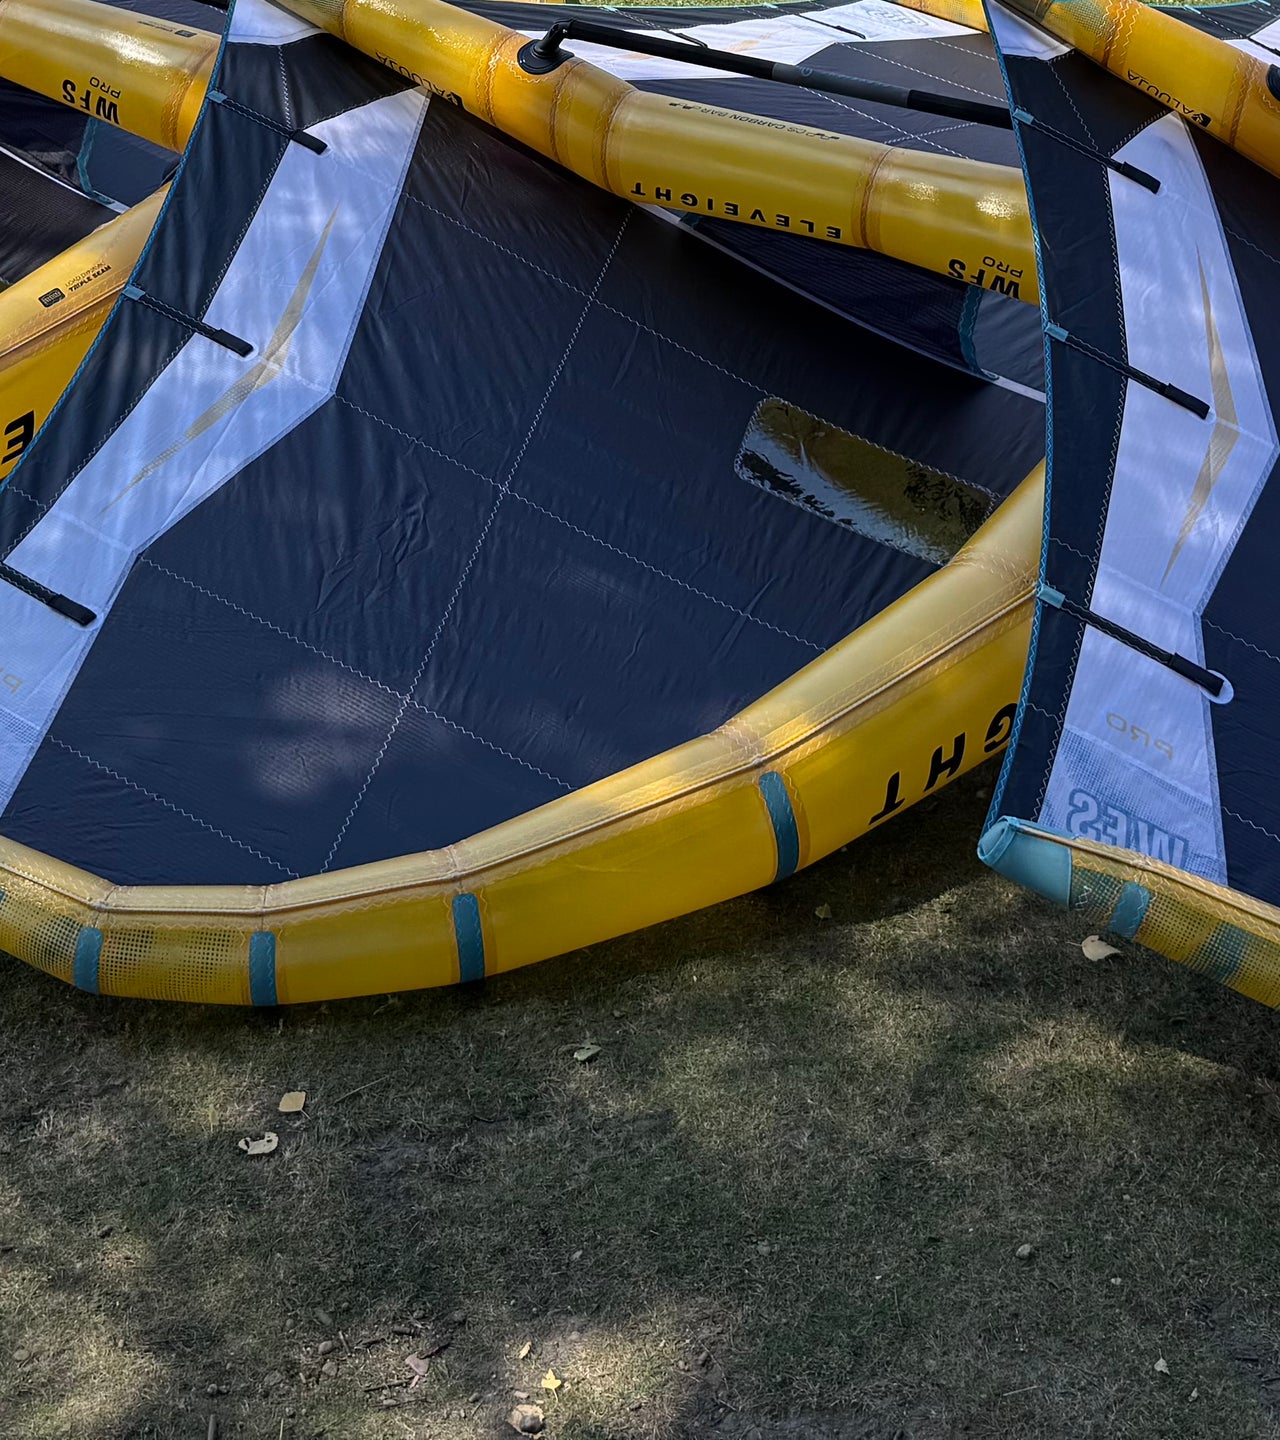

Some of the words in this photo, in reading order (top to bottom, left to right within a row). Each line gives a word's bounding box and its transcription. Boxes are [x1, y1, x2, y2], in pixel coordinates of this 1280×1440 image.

[89, 76, 122, 99] PRO
[62, 79, 120, 125] WFS
[729, 113, 786, 130] CARBON
[631, 182, 842, 240] ELEVEIGHT
[68, 276, 93, 292] TRIPLE
[92, 264, 112, 278] SEAM
[948, 258, 1020, 300] WFS
[982, 256, 1024, 279] PRO
